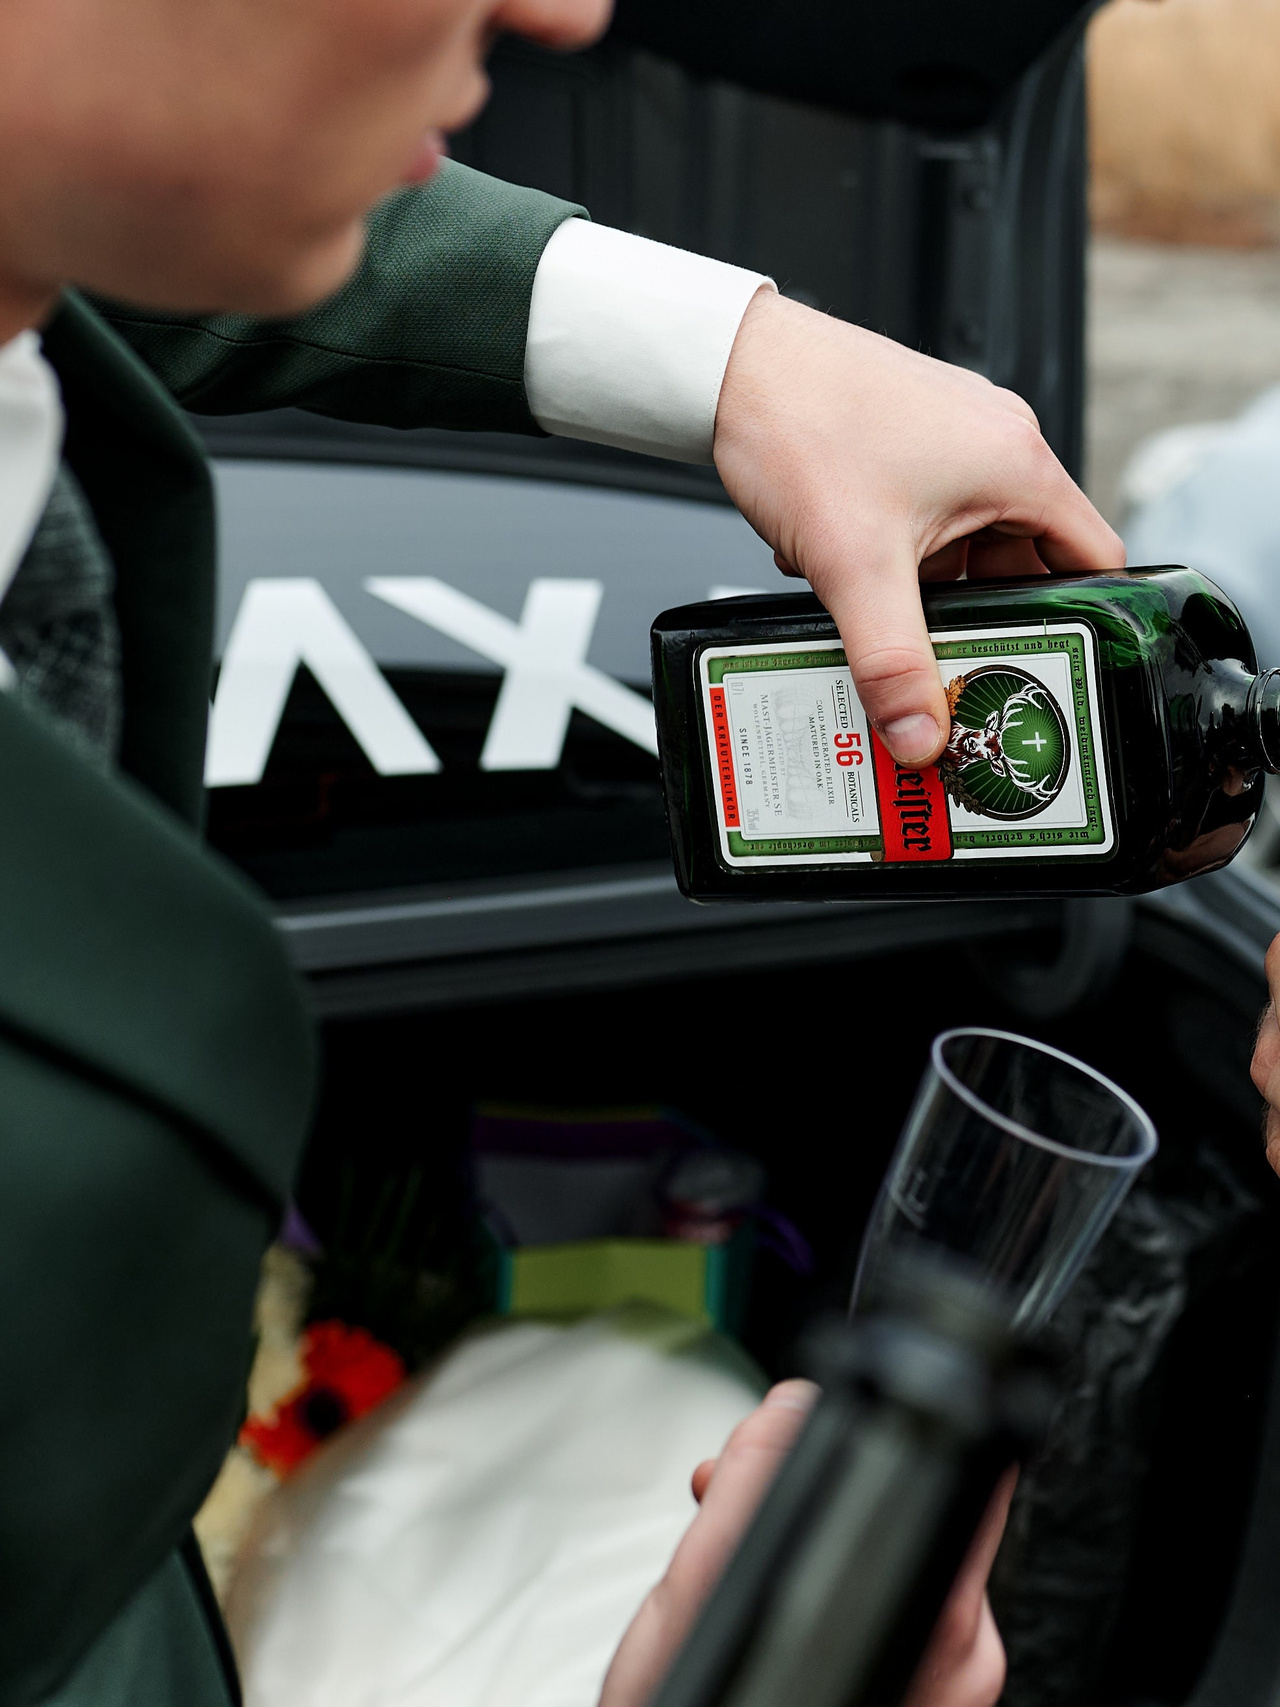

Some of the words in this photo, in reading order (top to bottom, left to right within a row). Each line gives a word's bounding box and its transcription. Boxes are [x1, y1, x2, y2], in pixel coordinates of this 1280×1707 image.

[1024, 640, 1043, 650] und
[1047, 638, 1070, 649] hegt
[1072, 646, 1082, 673] sein
[713, 695, 724, 718] DER
[816, 699, 825, 720] COLD
[835, 679, 849, 729] SELECTED
[739, 727, 751, 757] SINCE
[808, 716, 820, 755] MATURED
[819, 724, 832, 774] MACERATED
[760, 694, 780, 800] MAST-JÄGERMEISTER
[774, 803, 783, 817] SE
[814, 759, 821, 769] IN
[833, 733, 864, 767] 56
[717, 725, 736, 820] KRÄUTERLIKÖR
[744, 763, 754, 785] 1878
[815, 771, 824, 789] OAK
[826, 777, 835, 805] ELIXIR
[847, 771, 860, 823] BOTANICALS
[1068, 831, 1090, 841] wie
